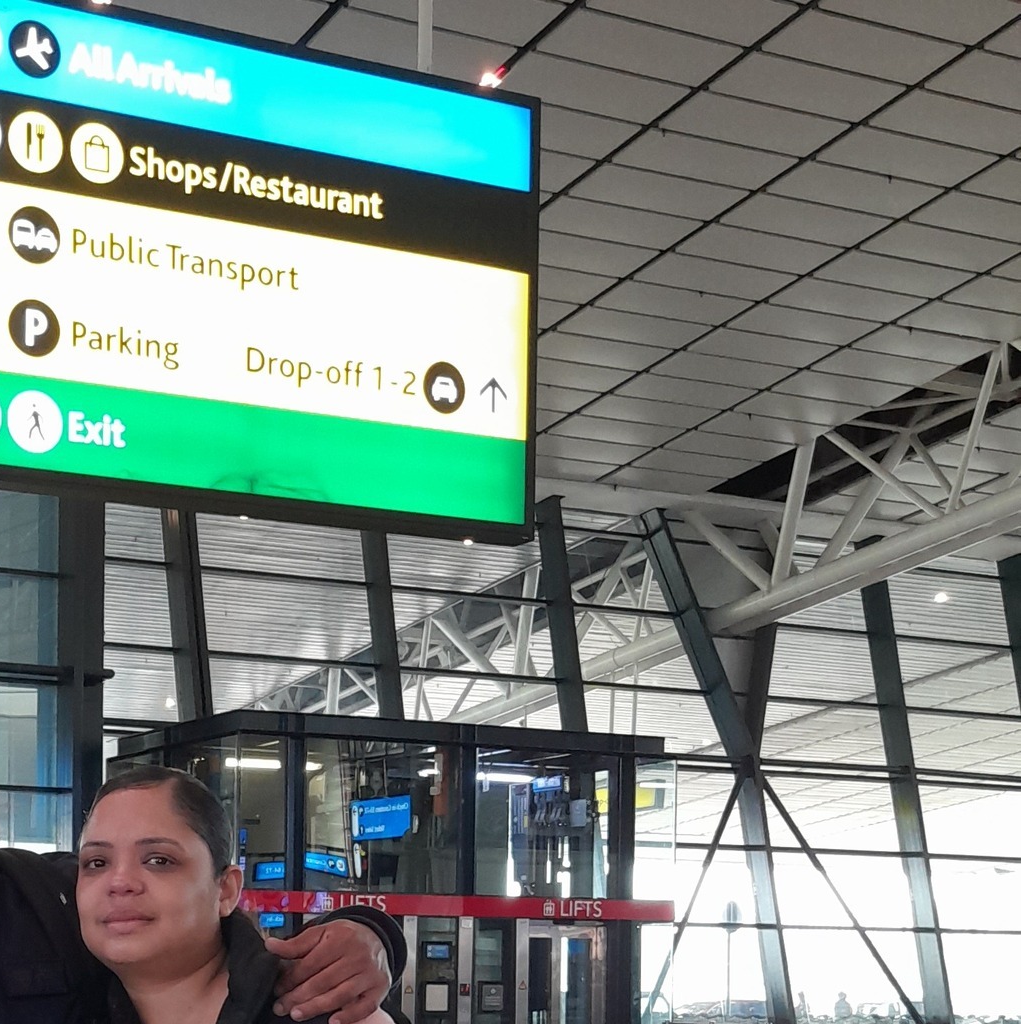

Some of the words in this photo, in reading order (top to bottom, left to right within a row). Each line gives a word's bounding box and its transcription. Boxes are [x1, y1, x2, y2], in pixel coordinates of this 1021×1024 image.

[68, 42, 115, 82] All
[116, 51, 233, 106] Arrivals
[72, 227, 160, 268] Public
[165, 243, 299, 291] Transport
[24, 307, 49, 347] P
[72, 320, 179, 370] Parking
[246, 346, 364, 388] Drop-off
[67, 410, 127, 449] Exit
[560, 900, 603, 917] LIFTS
